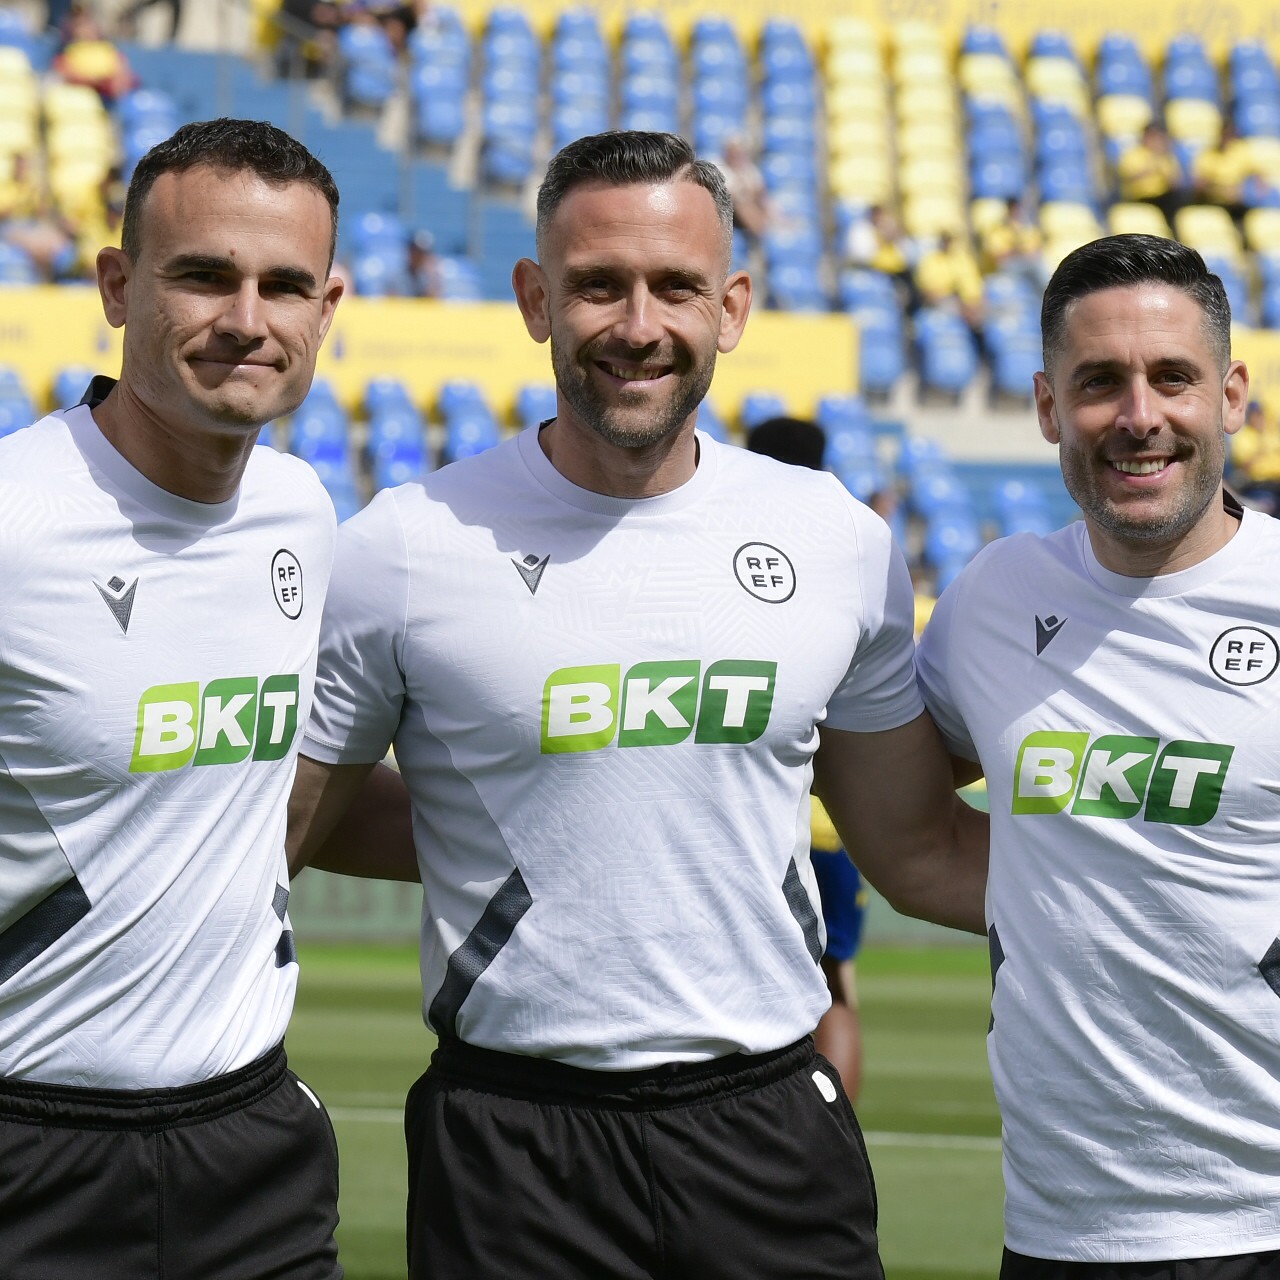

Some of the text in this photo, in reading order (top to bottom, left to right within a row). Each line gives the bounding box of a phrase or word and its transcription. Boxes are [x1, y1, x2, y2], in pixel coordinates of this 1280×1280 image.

[746, 557, 780, 570] RF
[278, 565, 296, 582] RF
[751, 575, 784, 588] EF
[281, 586, 298, 603] EF
[1227, 640, 1266, 654] RF
[1225, 658, 1263, 672] EF
[546, 674, 770, 739] BKT
[138, 690, 297, 757] BKT
[1017, 746, 1223, 809] BKT
